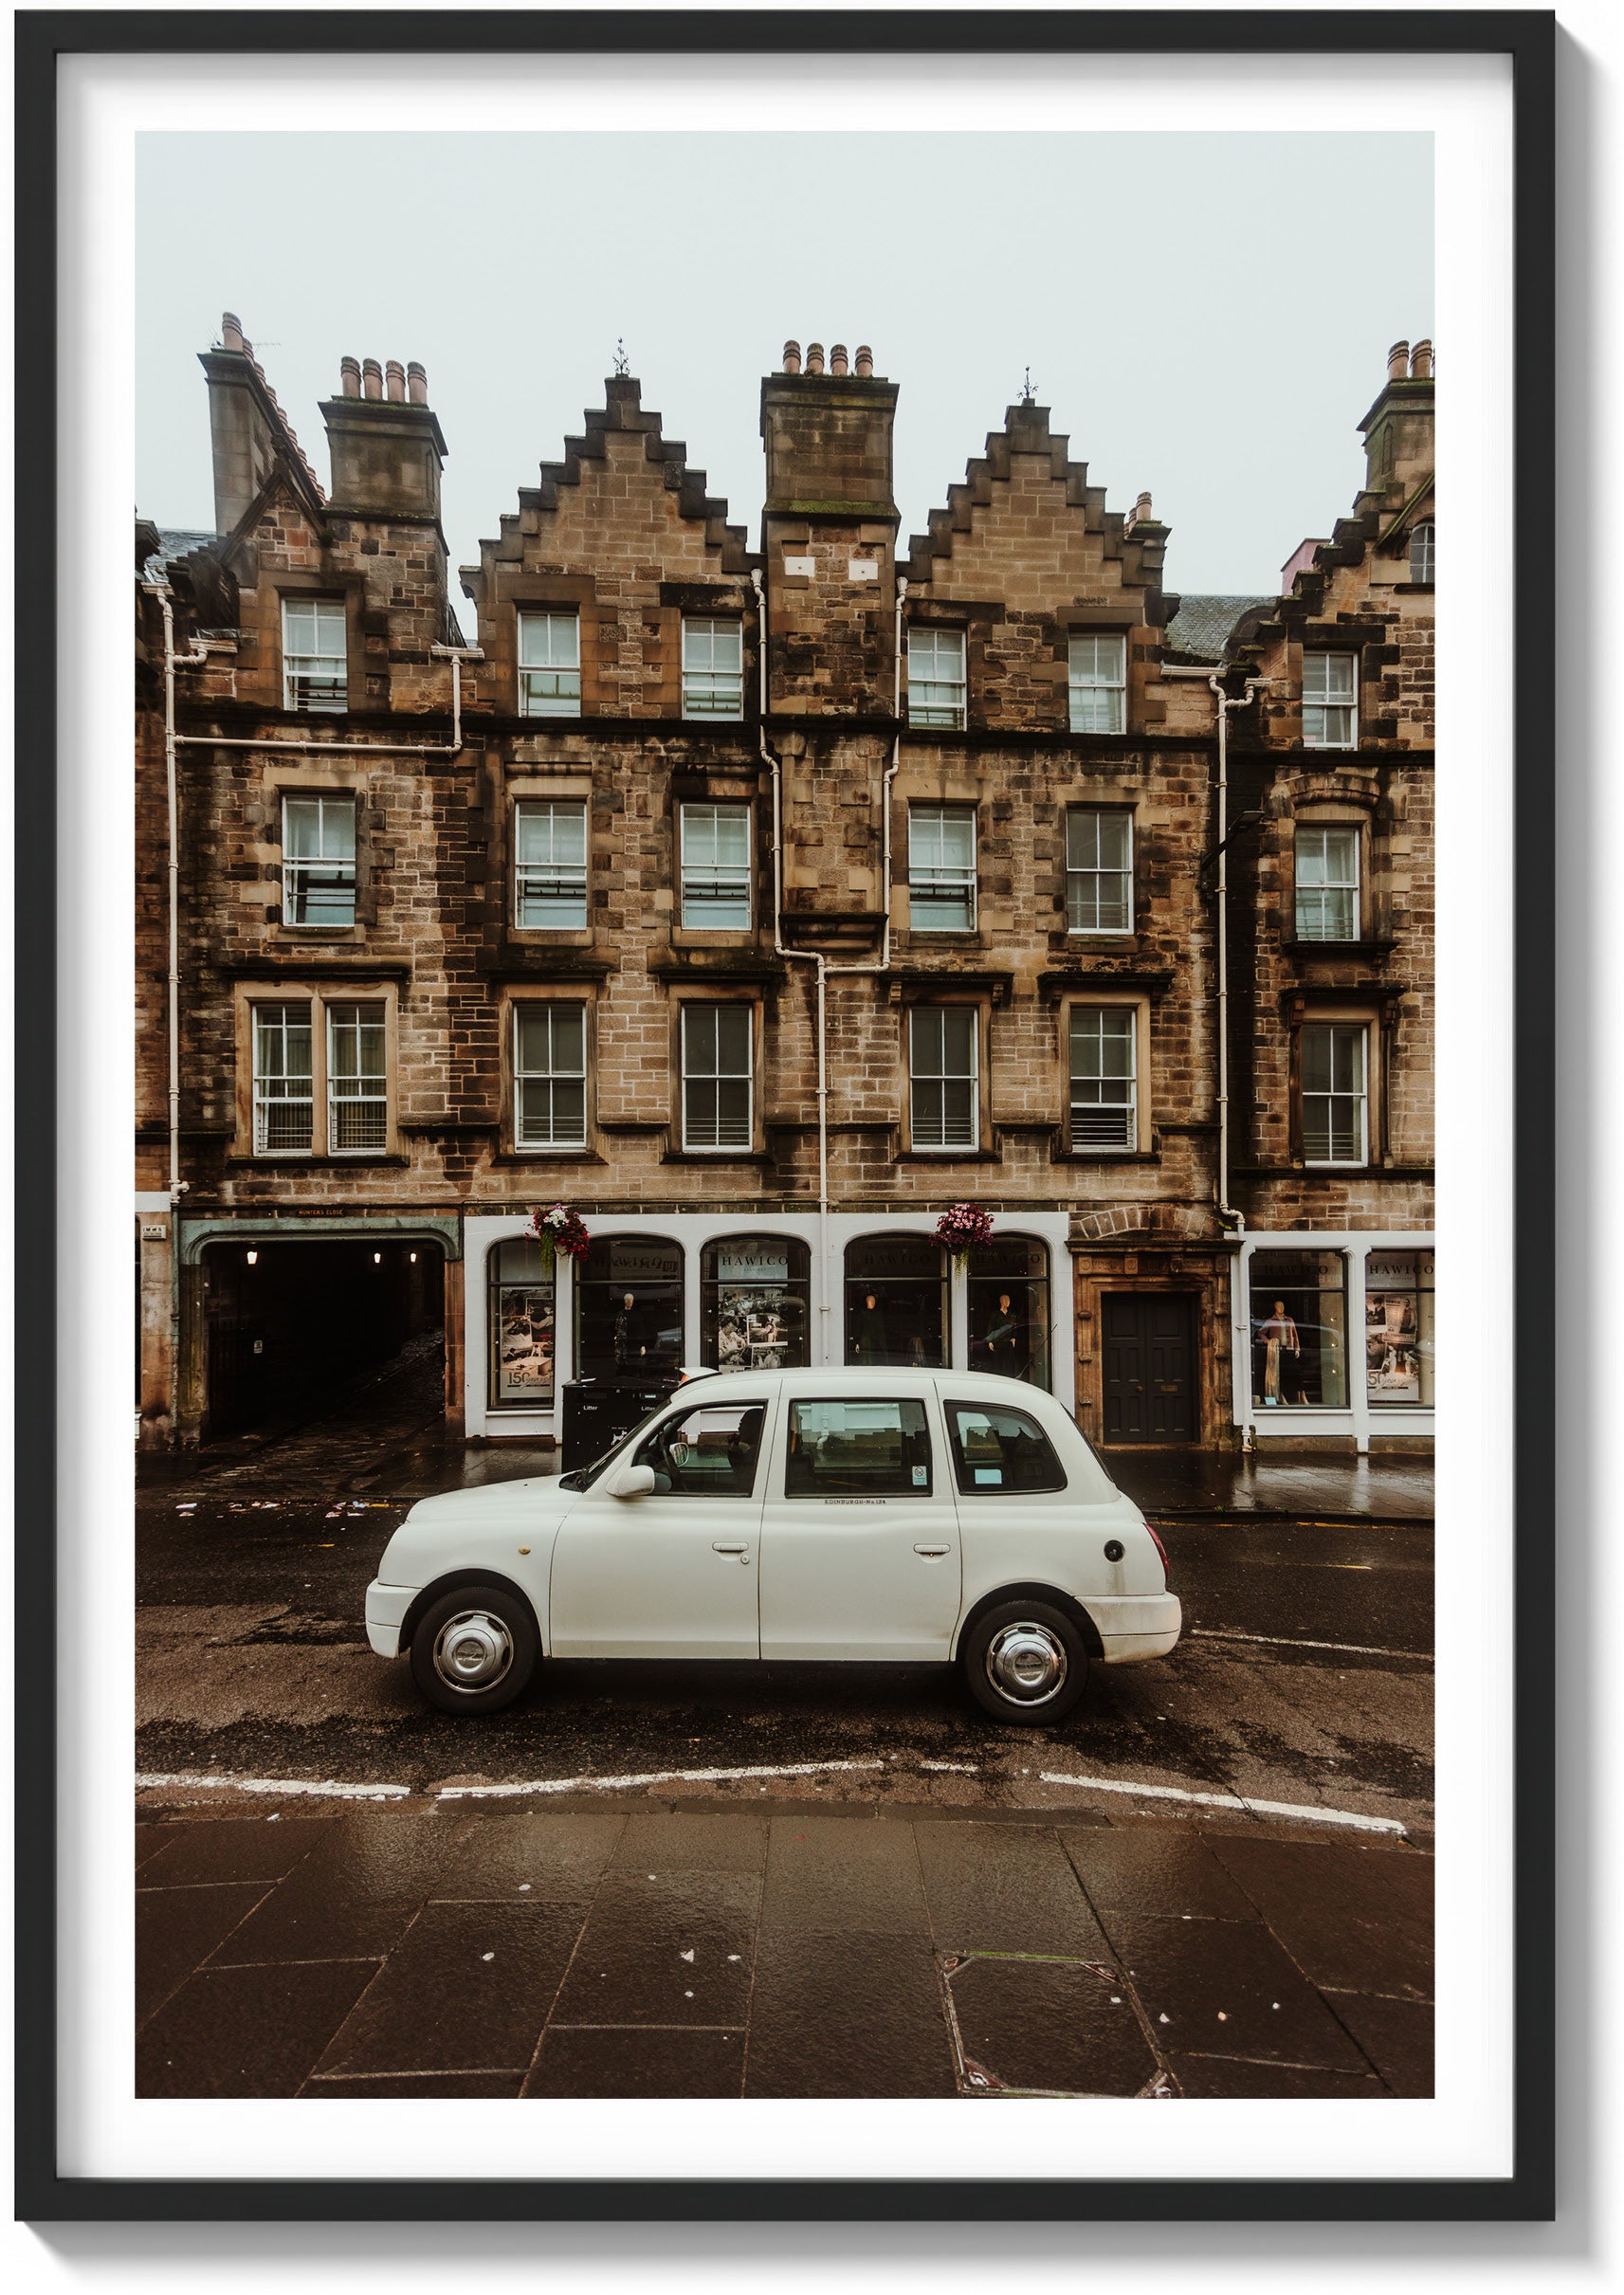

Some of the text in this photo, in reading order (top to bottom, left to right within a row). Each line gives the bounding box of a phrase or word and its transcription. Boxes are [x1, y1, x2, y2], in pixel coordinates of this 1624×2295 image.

[722, 1255, 789, 1266] HAWICO
[1263, 1265, 1328, 1275] HAWICO
[1369, 1265, 1433, 1275] HAWICO
[508, 1372, 531, 1384] 150
